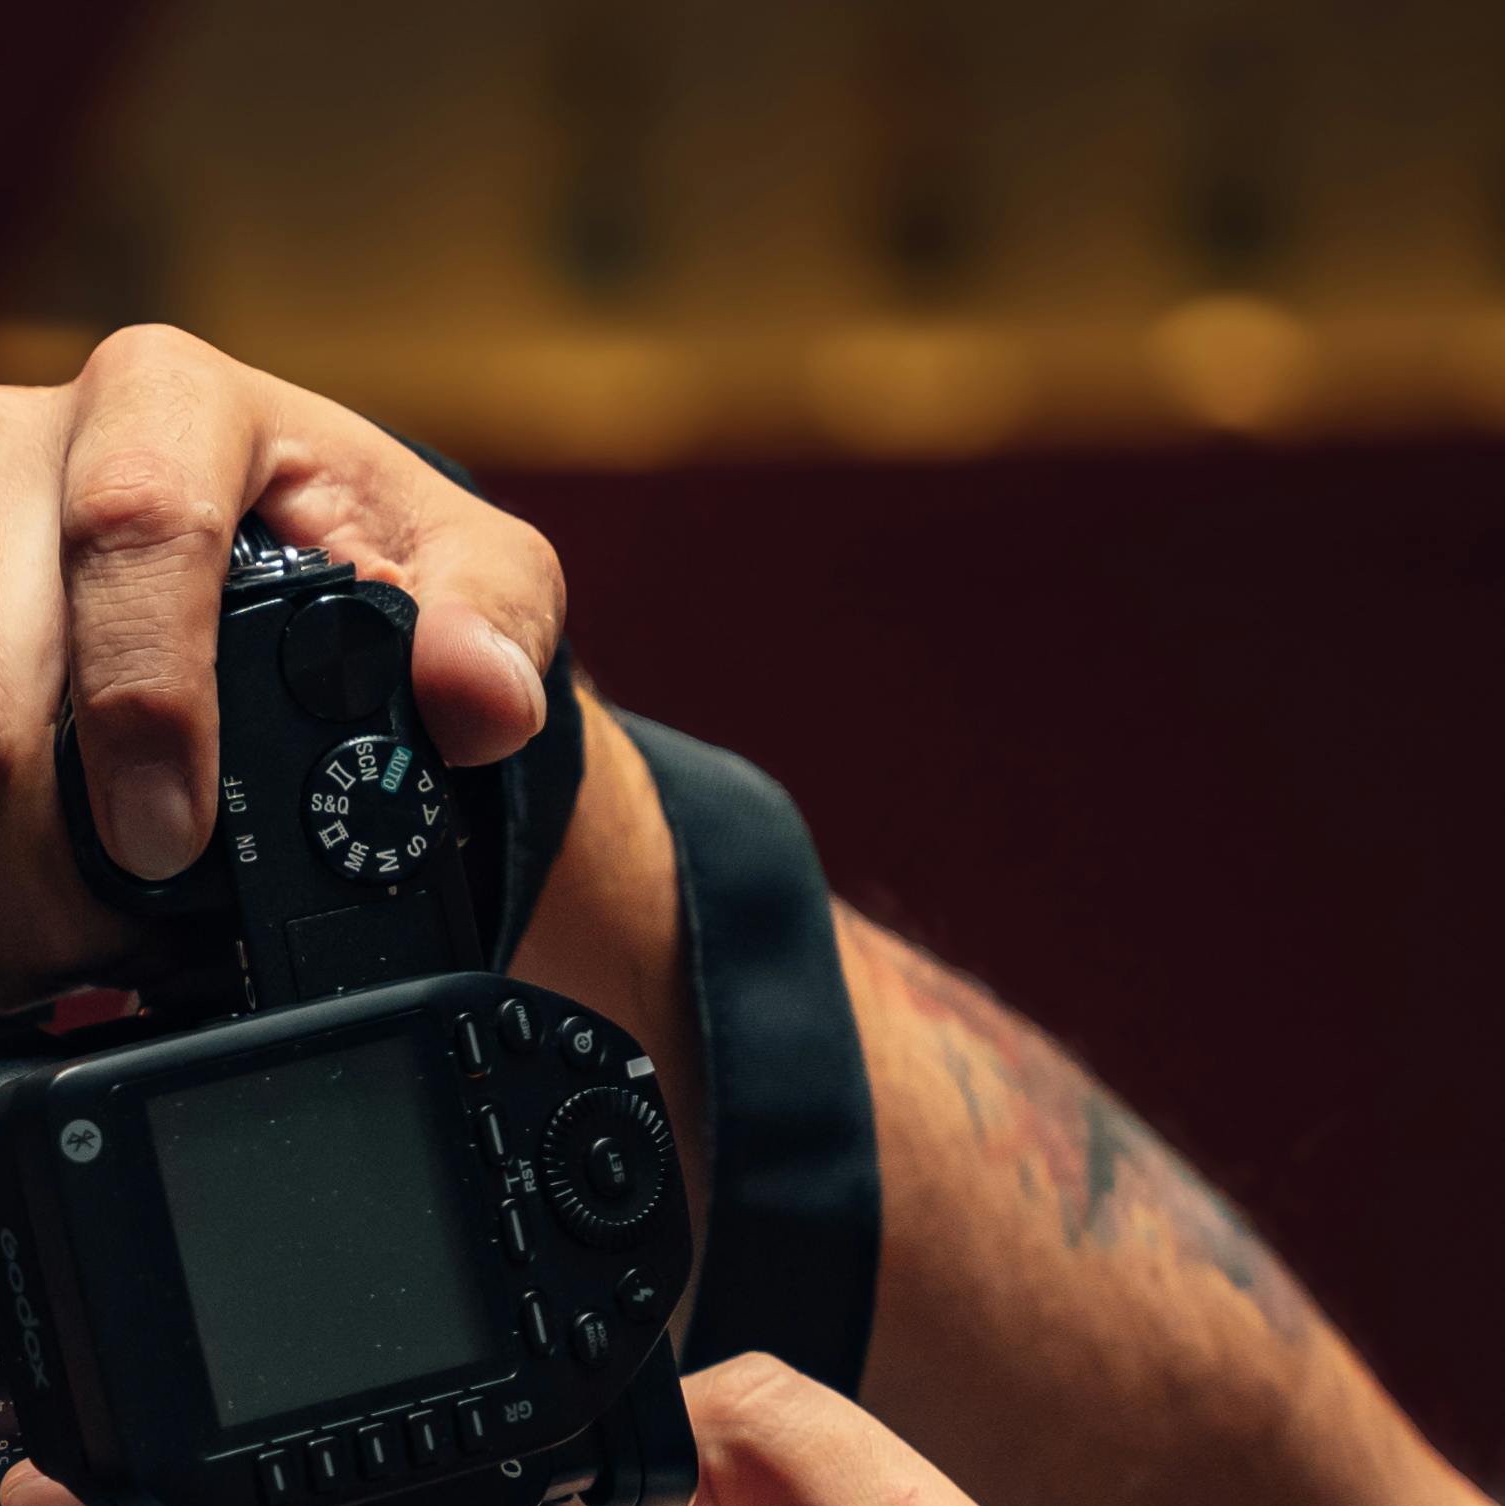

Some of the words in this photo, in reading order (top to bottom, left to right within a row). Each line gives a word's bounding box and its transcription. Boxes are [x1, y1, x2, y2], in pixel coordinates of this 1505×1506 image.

[355, 742, 379, 782] SCN
[382, 746, 411, 792] AUTO
[224, 776, 247, 813] OFF
[417, 769, 435, 793] P
[311, 793, 349, 815] S&Q
[422, 804, 440, 826] A
[235, 832, 258, 863] ON
[344, 841, 370, 873] MR
[376, 848, 400, 873] M
[406, 834, 427, 858] S
[515, 1004, 532, 1041] MENU
[518, 1158, 538, 1194] RST
[607, 1151, 626, 1184] SET
[503, 1399, 534, 1424] GR
